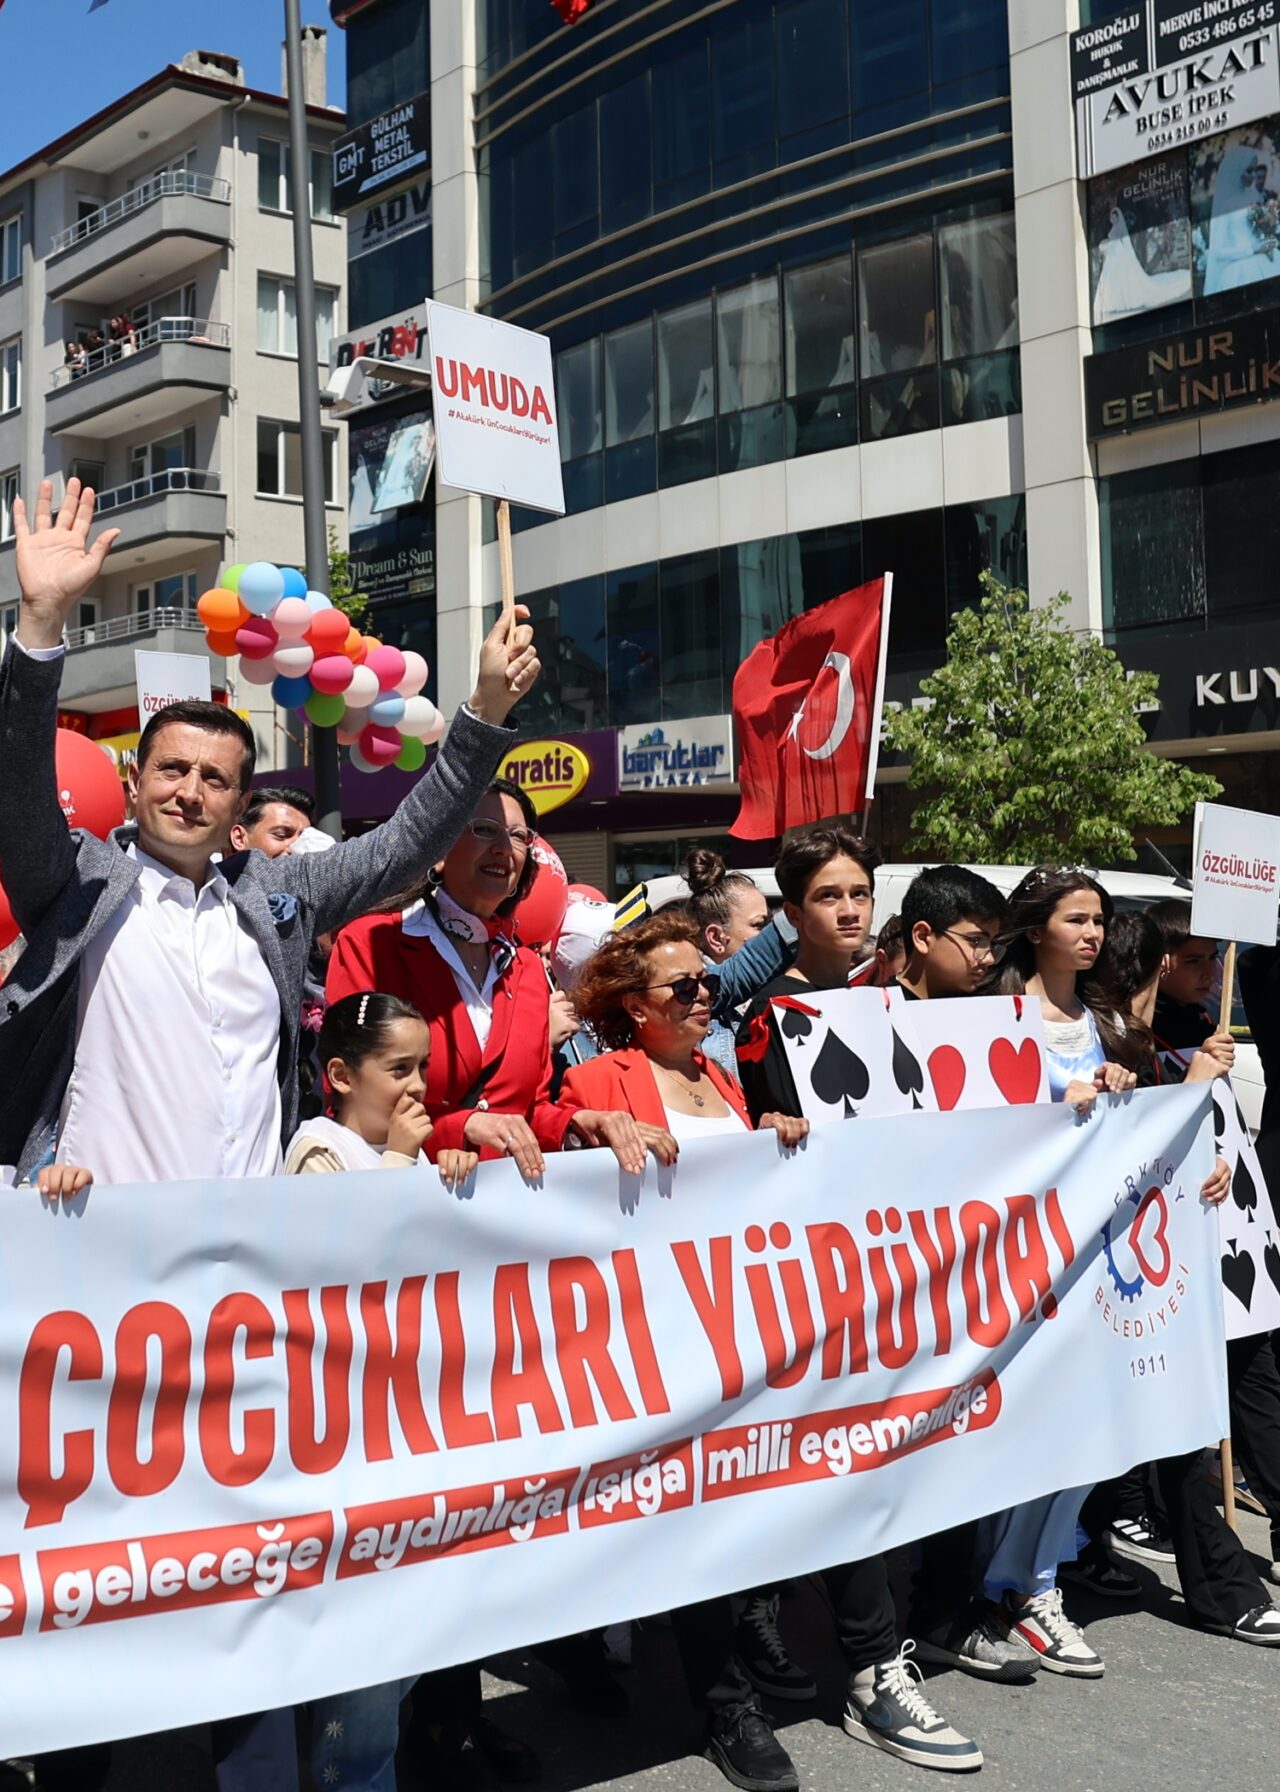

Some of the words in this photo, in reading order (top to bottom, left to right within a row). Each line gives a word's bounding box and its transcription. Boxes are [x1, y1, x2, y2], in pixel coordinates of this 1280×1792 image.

[1075, 13, 1140, 52] KOROĞLU
[1159, 7, 1202, 37] MERVE
[1179, 27, 1210, 52] 0533
[1212, 17, 1237, 39] 486
[1238, 9, 1256, 29] 65
[1257, 1, 1275, 22] 45
[1090, 40, 1123, 61] HUKUK
[1103, 58, 1111, 68] &
[1076, 59, 1139, 92] DANIŞMANLIK
[1102, 34, 1274, 125] AVUKAT
[371, 104, 414, 139] GÜLHAN
[1136, 103, 1183, 136] BUSE
[1188, 84, 1236, 116] İPEK
[374, 125, 410, 154] METAL
[1147, 131, 1174, 152] 0534
[1175, 124, 1196, 143] 215
[1197, 116, 1212, 134] 00
[1214, 110, 1229, 128] 45
[339, 147, 366, 175] GMT
[370, 139, 415, 173] TEKSTİL
[1138, 162, 1167, 181] NUR
[1147, 330, 1235, 376] NUR
[436, 356, 553, 425] UMUDA
[358, 558, 395, 578] Dream
[398, 550, 407, 569] &
[409, 548, 433, 566] Sun
[504, 748, 575, 785] gratis
[623, 739, 725, 774] barutlar
[644, 772, 702, 787] PLAZA
[1202, 850, 1277, 883] ÖZGÜRLÜĞE
[18, 1246, 670, 1529] ÇOCUKLARI
[670, 1187, 1076, 1402] YÜRÜYOR!
[1130, 1354, 1166, 1378] 1911
[52, 1523, 324, 1628] geleceğe
[348, 1475, 564, 1571] aydınlığa
[584, 1450, 687, 1515] ışığa
[708, 1423, 793, 1485] milli
[800, 1378, 988, 1475] egemenliğe
